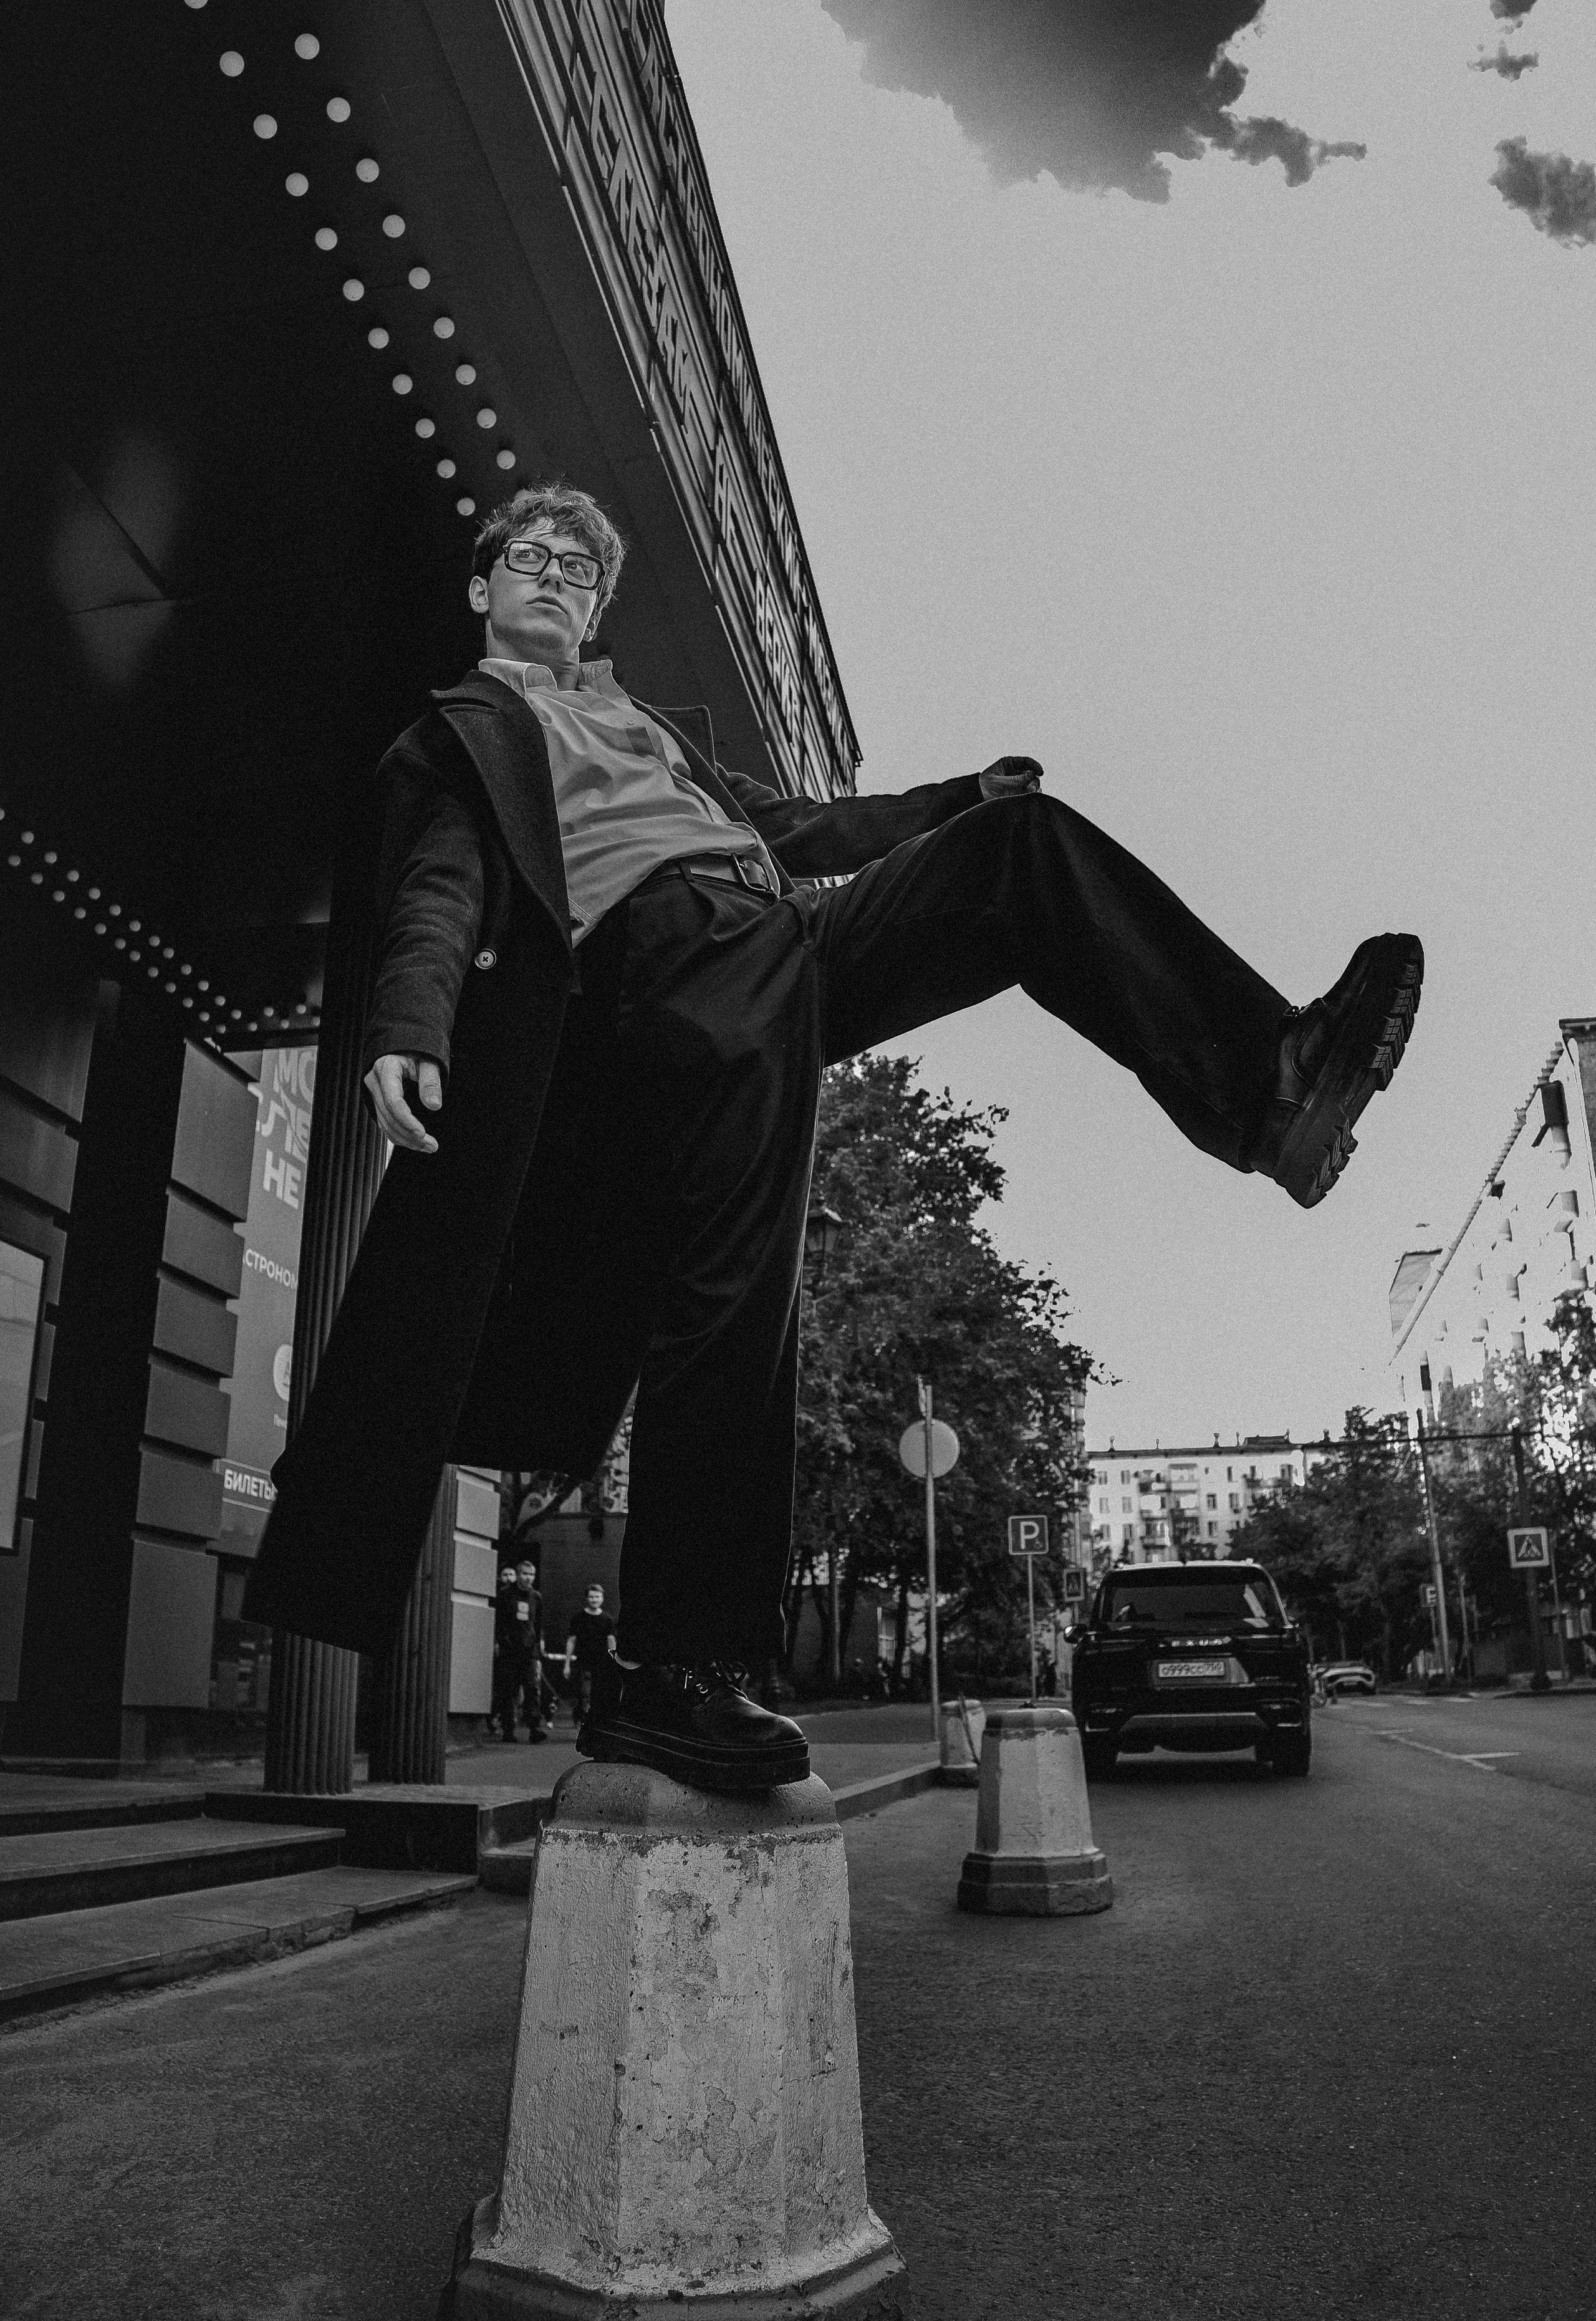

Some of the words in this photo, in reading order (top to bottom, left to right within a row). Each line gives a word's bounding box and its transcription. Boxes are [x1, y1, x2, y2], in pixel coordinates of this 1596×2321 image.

[590, 70, 692, 418] СЛЕЗАМ
[714, 440, 738, 562] НЕ
[263, 1149, 302, 1210] НЕ
[224, 1468, 276, 1501] БИЛЕТЫ
[1020, 1521, 1039, 1550] P
